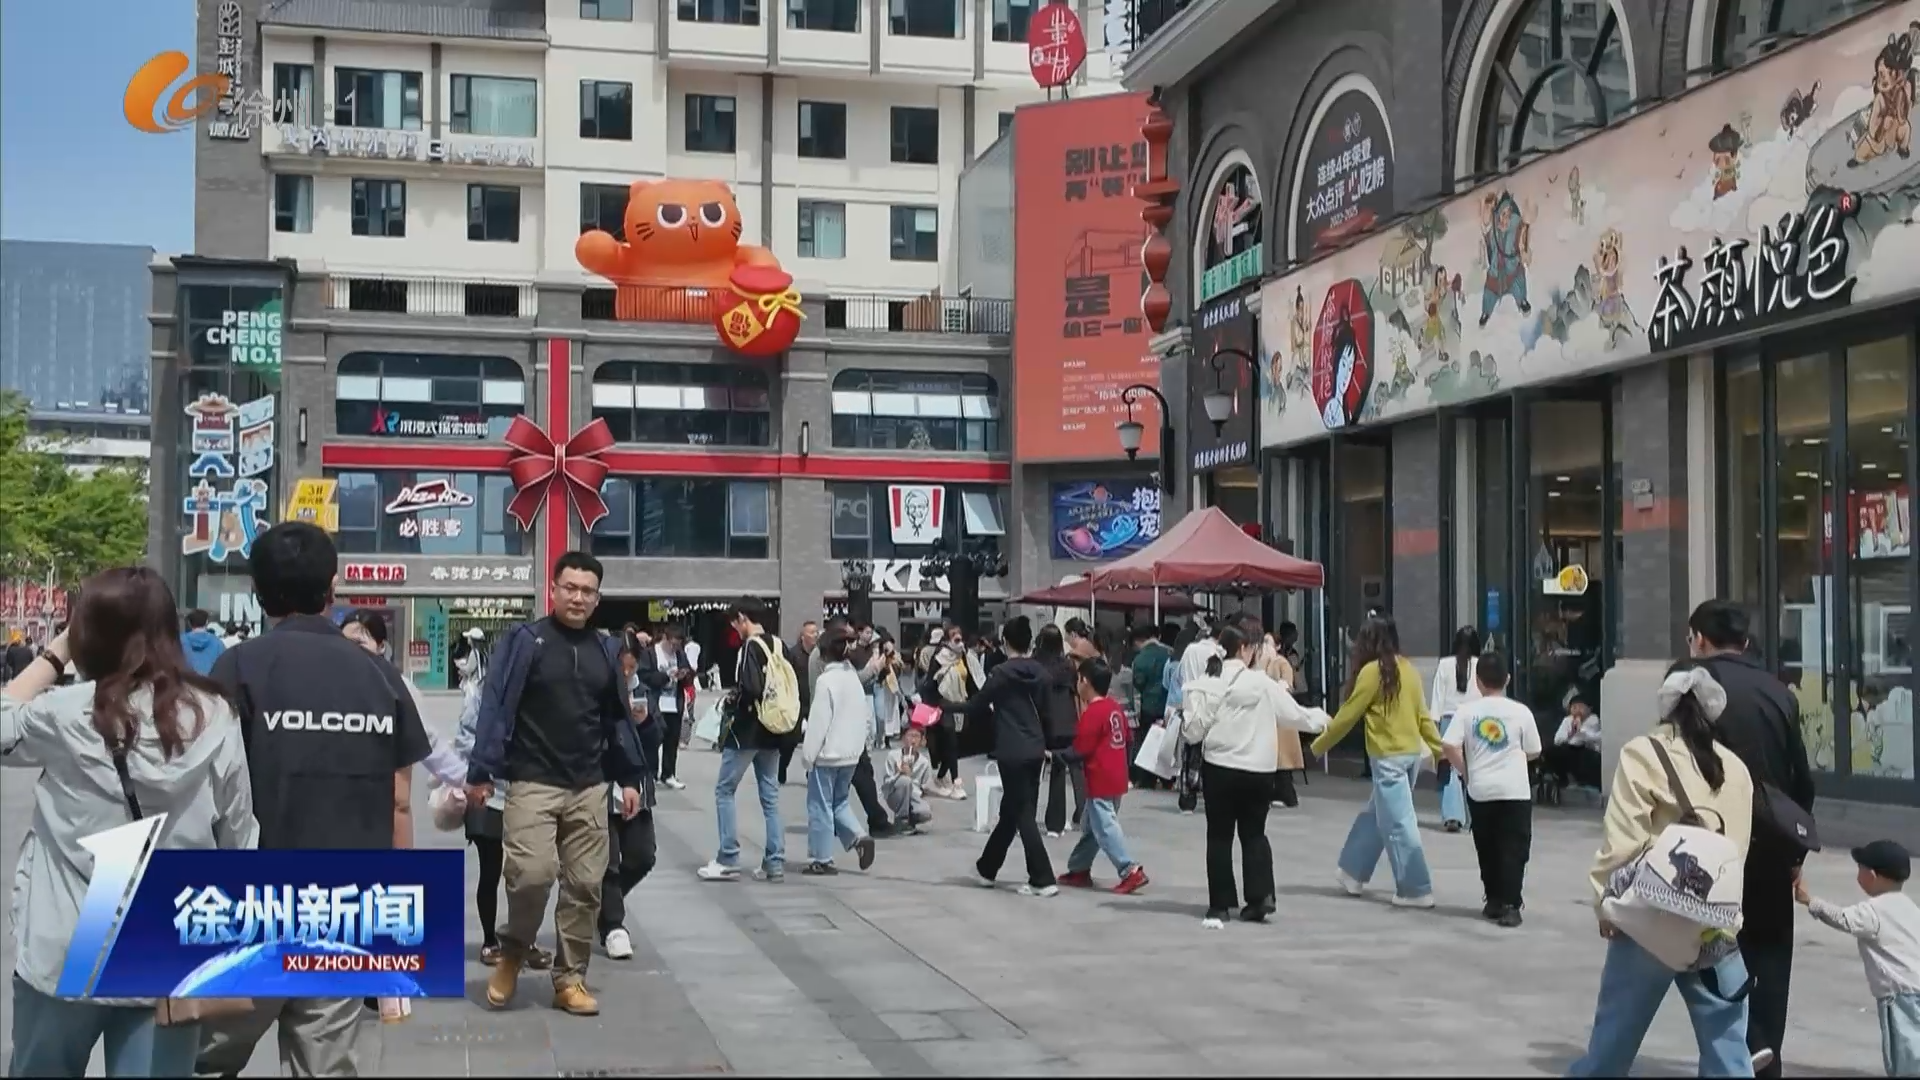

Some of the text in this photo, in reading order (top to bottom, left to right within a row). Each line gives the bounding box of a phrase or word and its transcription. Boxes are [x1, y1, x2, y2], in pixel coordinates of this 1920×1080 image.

[1650, 204, 1855, 348] 茶颜悦色
[223, 310, 282, 328] PENG
[206, 327, 282, 346] CHENG
[231, 346, 282, 364] NO.1
[396, 486, 437, 504] Pizza
[399, 517, 463, 538] 必胜客
[263, 710, 394, 735] VOLCOM
